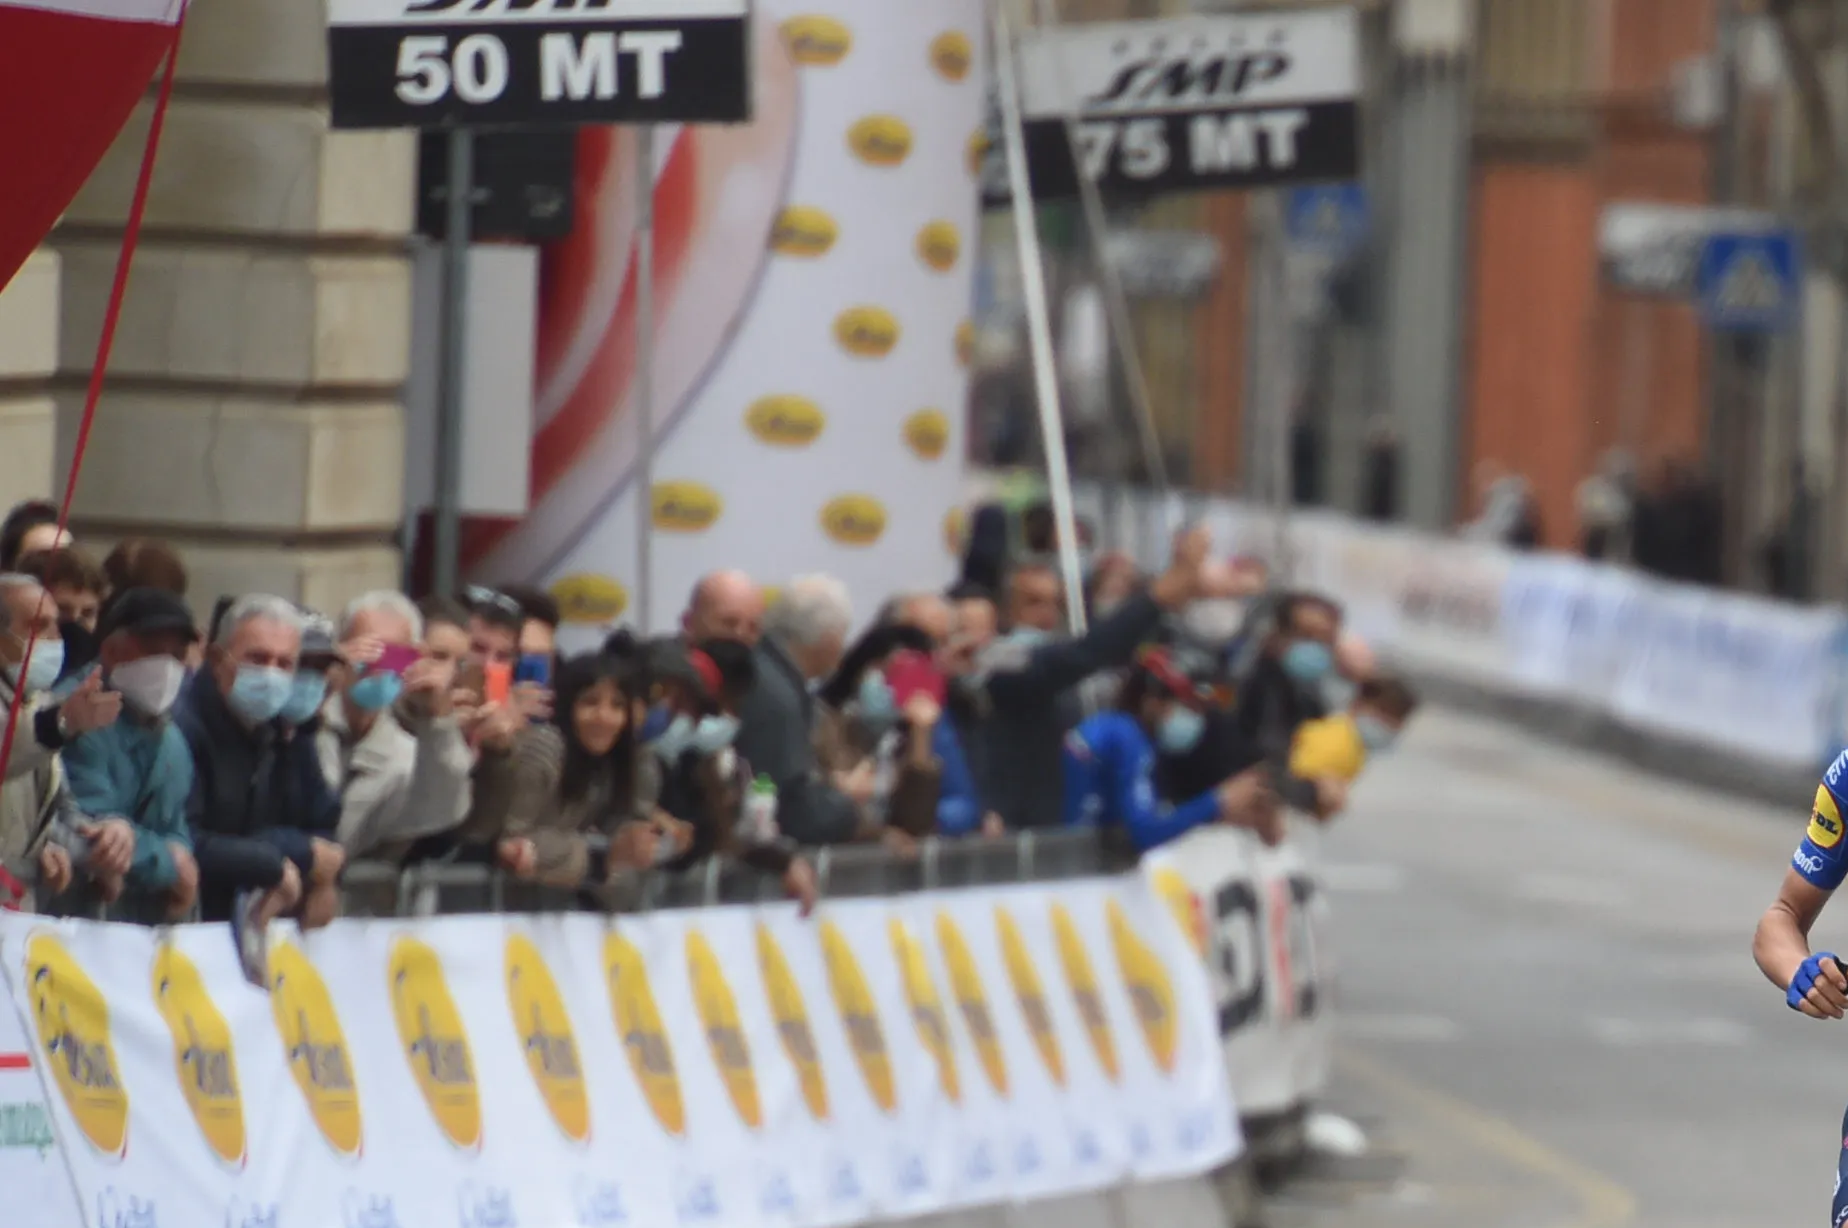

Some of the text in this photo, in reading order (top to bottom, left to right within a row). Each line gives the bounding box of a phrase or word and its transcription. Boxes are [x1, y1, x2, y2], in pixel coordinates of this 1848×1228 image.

[396, 30, 683, 104] 50 MT
[1086, 51, 1293, 104] SMP
[1075, 108, 1308, 180] 75 MT
